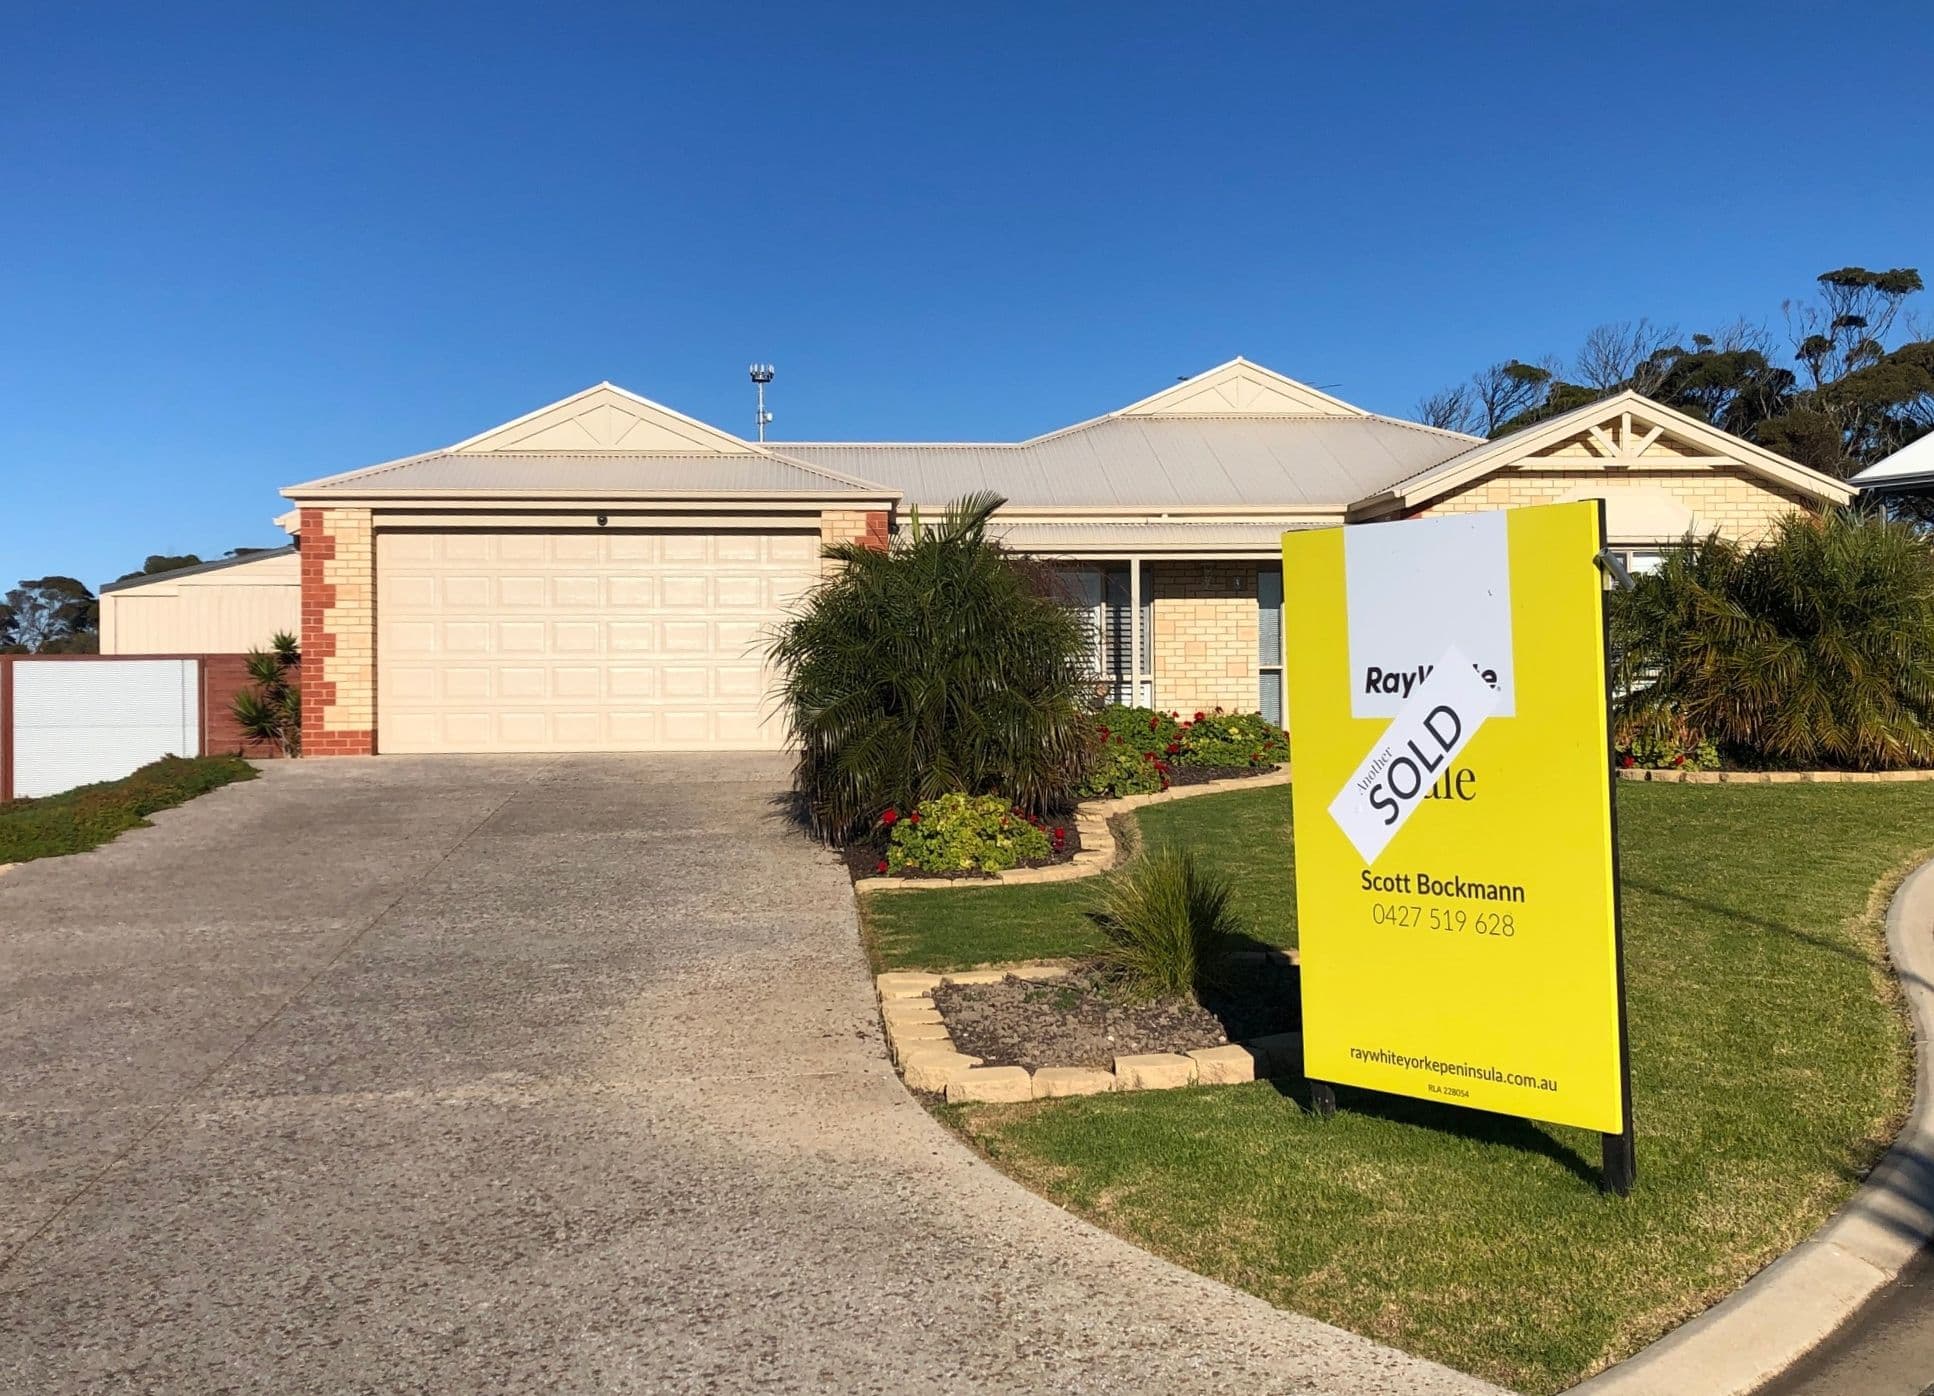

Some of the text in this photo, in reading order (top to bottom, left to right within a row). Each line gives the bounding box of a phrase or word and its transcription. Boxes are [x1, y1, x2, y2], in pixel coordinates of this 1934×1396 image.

[1365, 663, 1498, 699] Raye
[1356, 746, 1393, 796] Another
[1369, 705, 1462, 826] SOLD
[1361, 869, 1525, 903] Scott Bockmann
[1372, 903, 1515, 937] 0427 519 628
[1350, 1046, 1558, 1092] raywhiteyorkepeninsula.com.au
[1428, 1084, 1442, 1094] RLA
